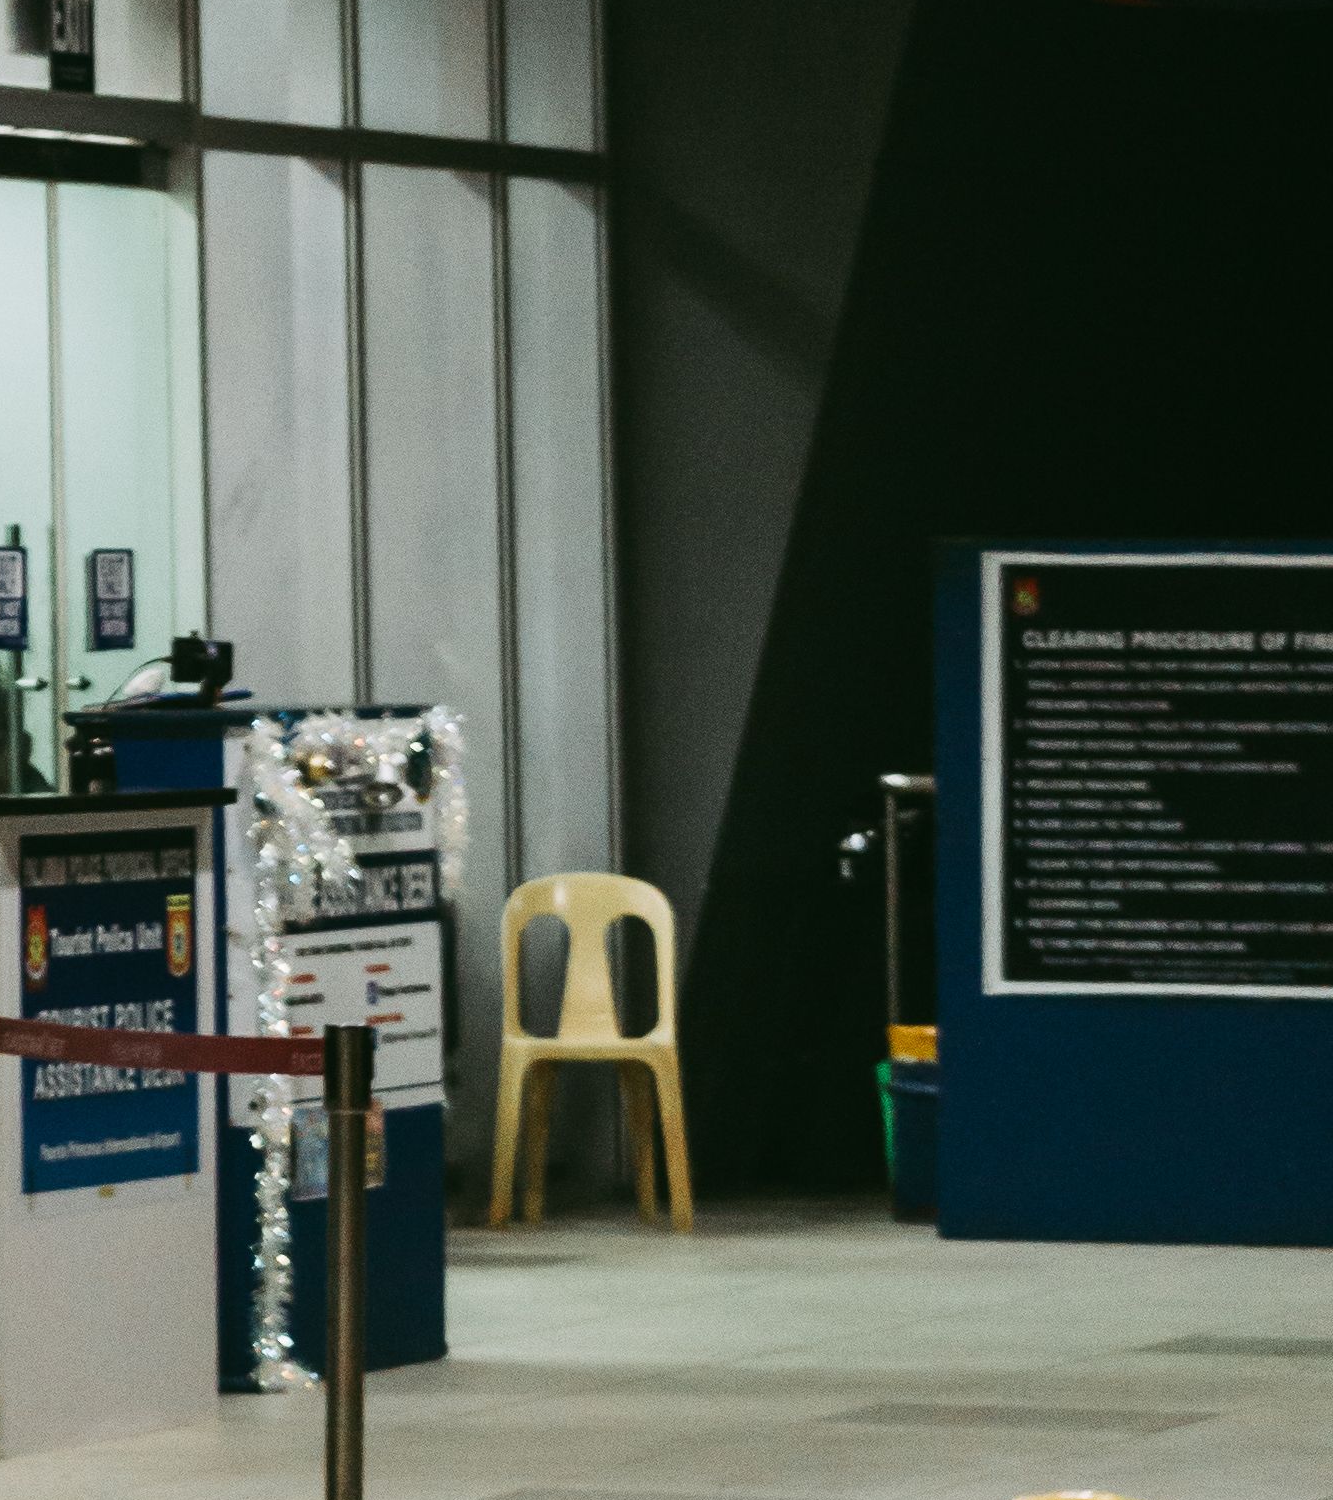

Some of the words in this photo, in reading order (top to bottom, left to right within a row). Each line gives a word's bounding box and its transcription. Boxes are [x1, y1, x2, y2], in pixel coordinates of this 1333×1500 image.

[1022, 630, 1125, 650] CLEARING
[1131, 631, 1254, 651] PROCEDURE
[1261, 631, 1286, 651] OF
[49, 926, 93, 957] Tourist
[96, 923, 134, 953] Police
[136, 921, 164, 950] Unit
[37, 1004, 110, 1030] RIST
[34, 1062, 136, 1100] ASSISTANCE
